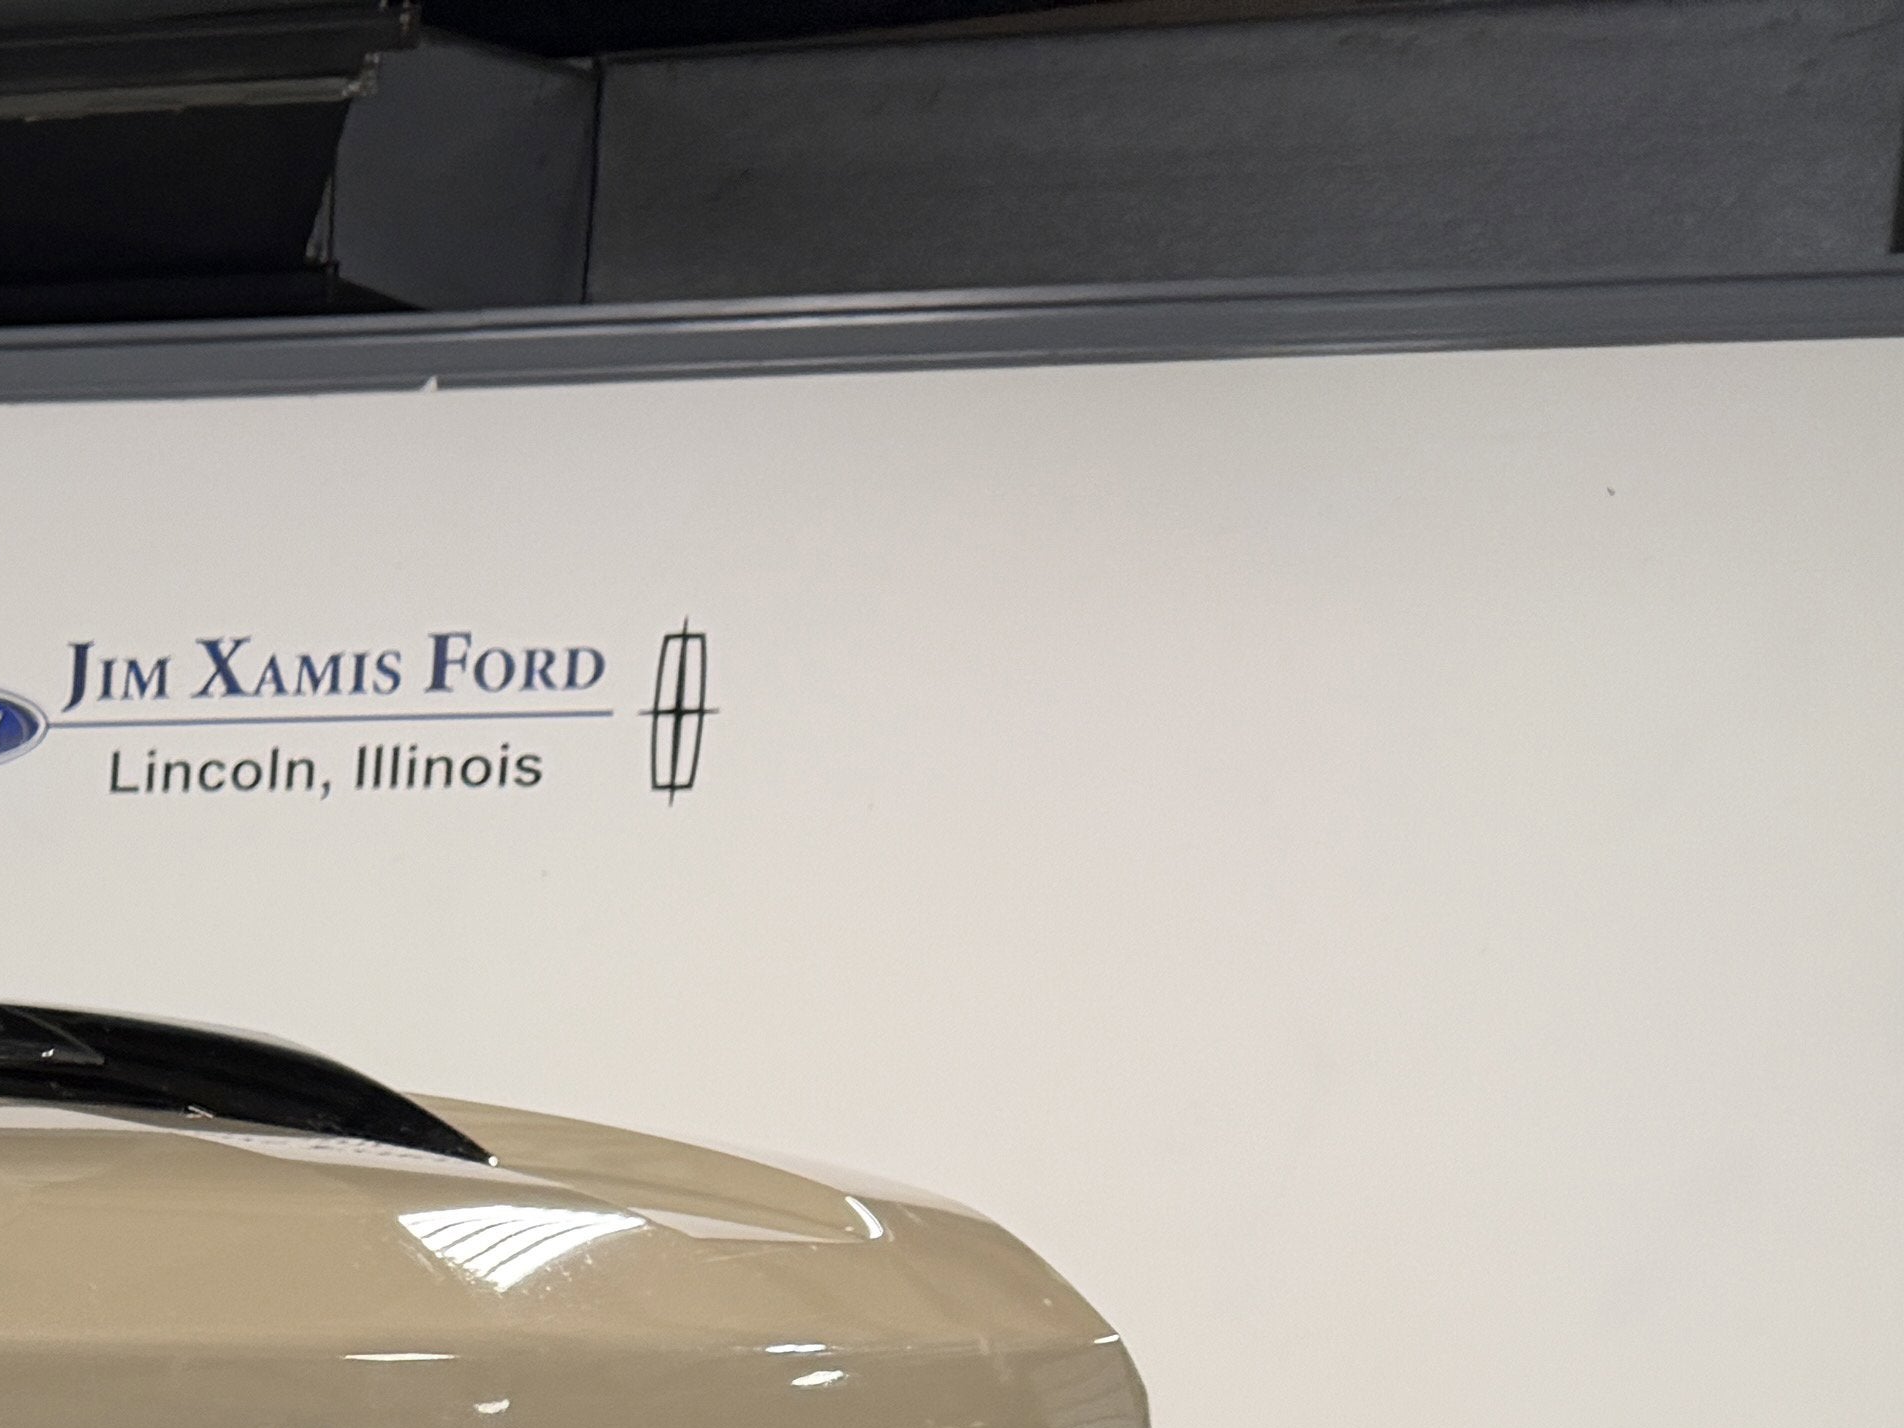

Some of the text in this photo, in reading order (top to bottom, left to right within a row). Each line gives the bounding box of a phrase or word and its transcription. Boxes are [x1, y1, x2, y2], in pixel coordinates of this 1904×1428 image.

[60, 631, 606, 713] JIM XAMIS FORD
[108, 743, 544, 800] Lincoln, Illinois
